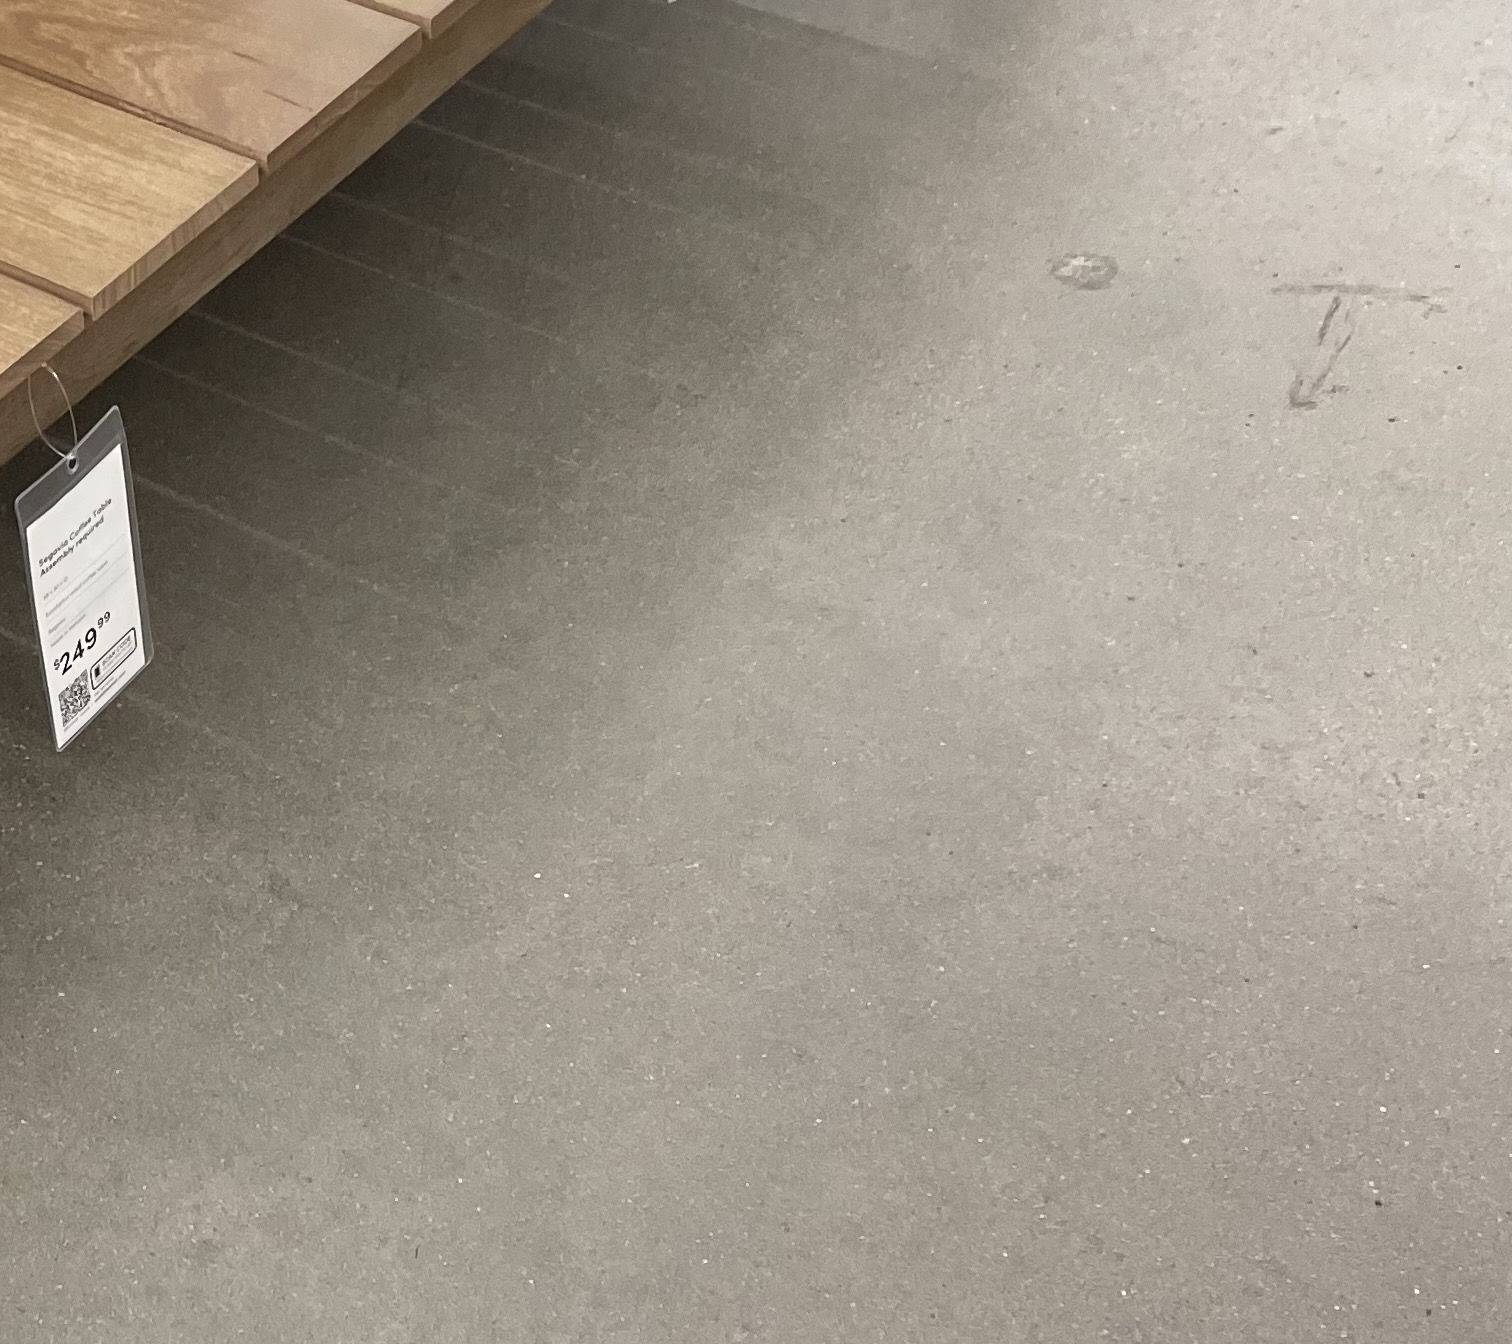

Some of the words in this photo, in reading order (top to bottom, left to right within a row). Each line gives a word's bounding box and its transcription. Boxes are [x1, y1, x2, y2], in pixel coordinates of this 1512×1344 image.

[69, 517, 92, 541] Coffee
[93, 498, 112, 517] Table
[40, 545, 75, 578] Assembly
[75, 515, 105, 548] required
